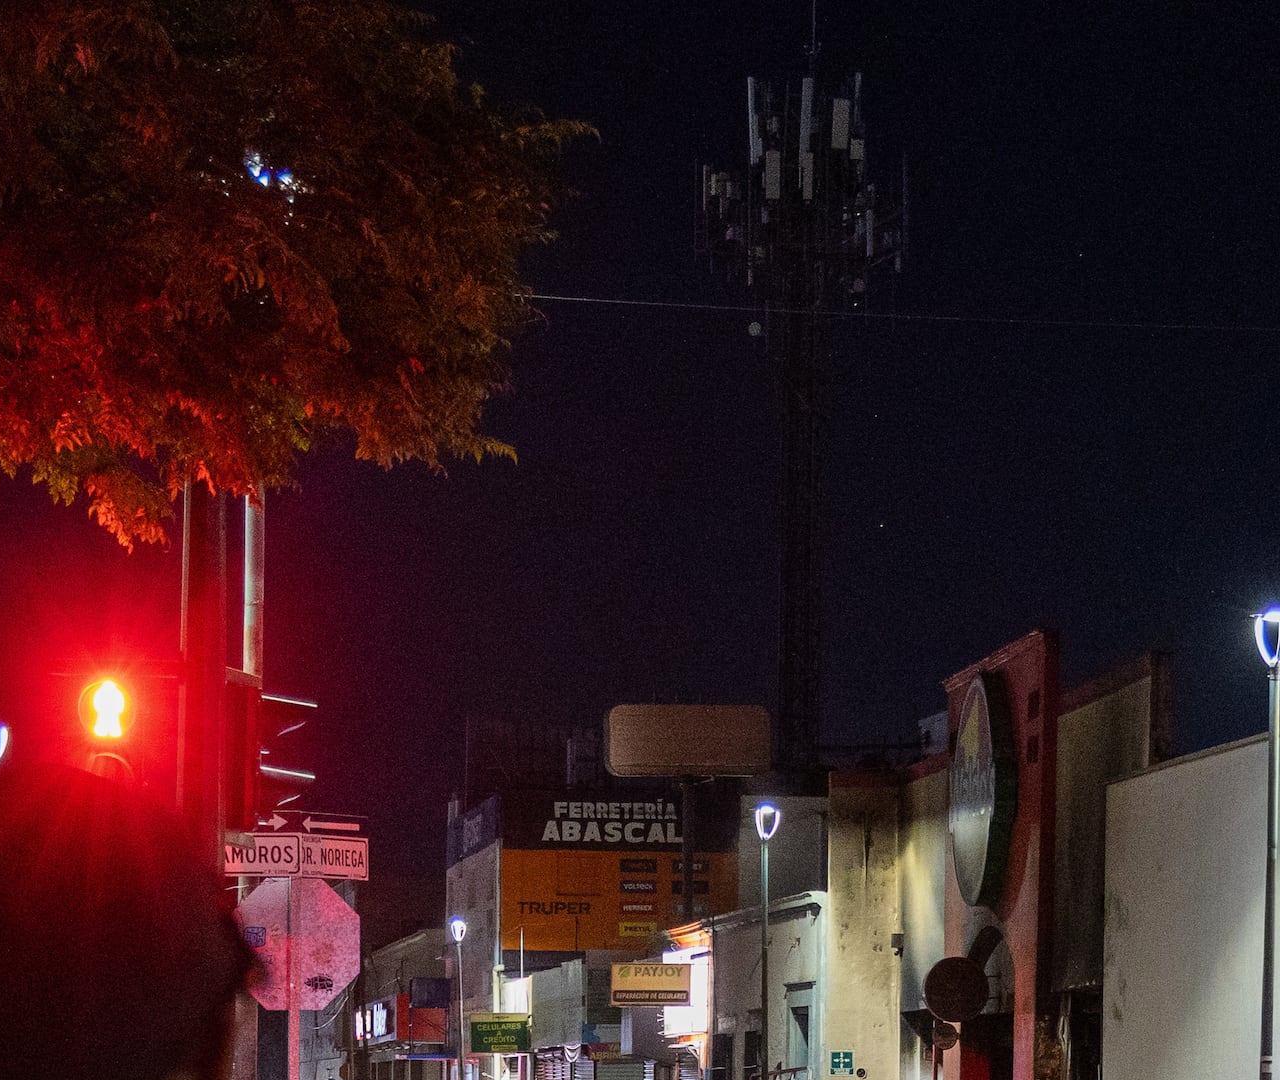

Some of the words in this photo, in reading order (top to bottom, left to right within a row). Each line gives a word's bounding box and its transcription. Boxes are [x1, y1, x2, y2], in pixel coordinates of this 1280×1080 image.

[554, 798, 677, 820] FERRETERÍA
[542, 820, 683, 844] ABASCAL
[320, 847, 364, 868] NORIEGA
[517, 901, 591, 916] TRUPER
[634, 966, 684, 977] PAYJOY
[650, 992, 657, 1000] DE
[658, 992, 687, 1000] CELULARES
[476, 1022, 522, 1032] CELULARES
